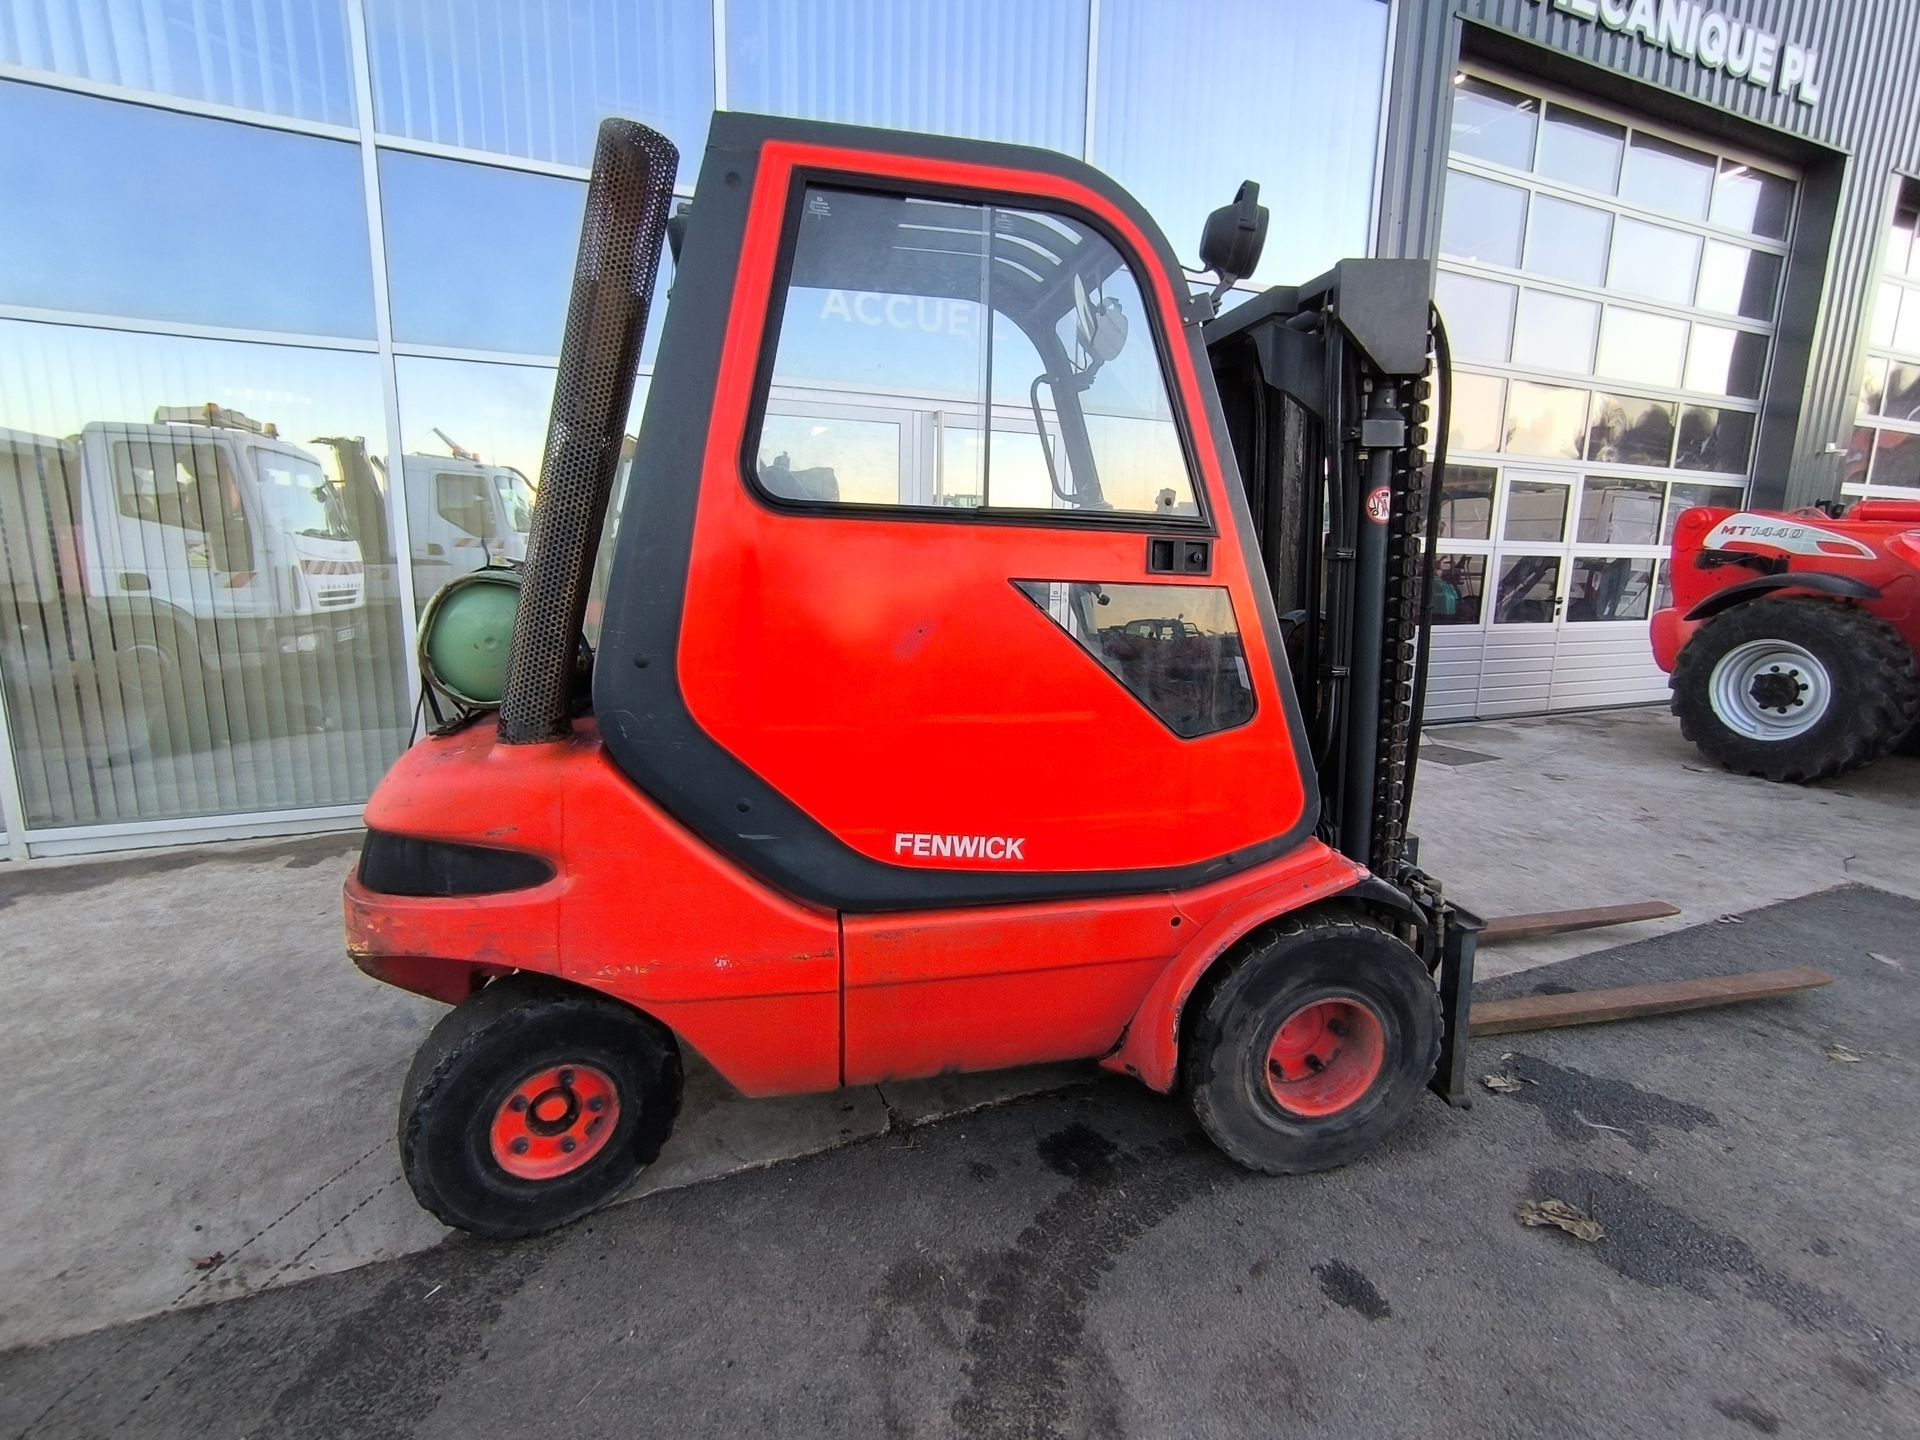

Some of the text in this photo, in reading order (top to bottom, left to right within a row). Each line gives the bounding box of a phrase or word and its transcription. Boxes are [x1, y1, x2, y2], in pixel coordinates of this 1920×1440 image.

[1532, 0, 1819, 104] CANIQUE PL
[894, 832, 1026, 861] FENWICK
